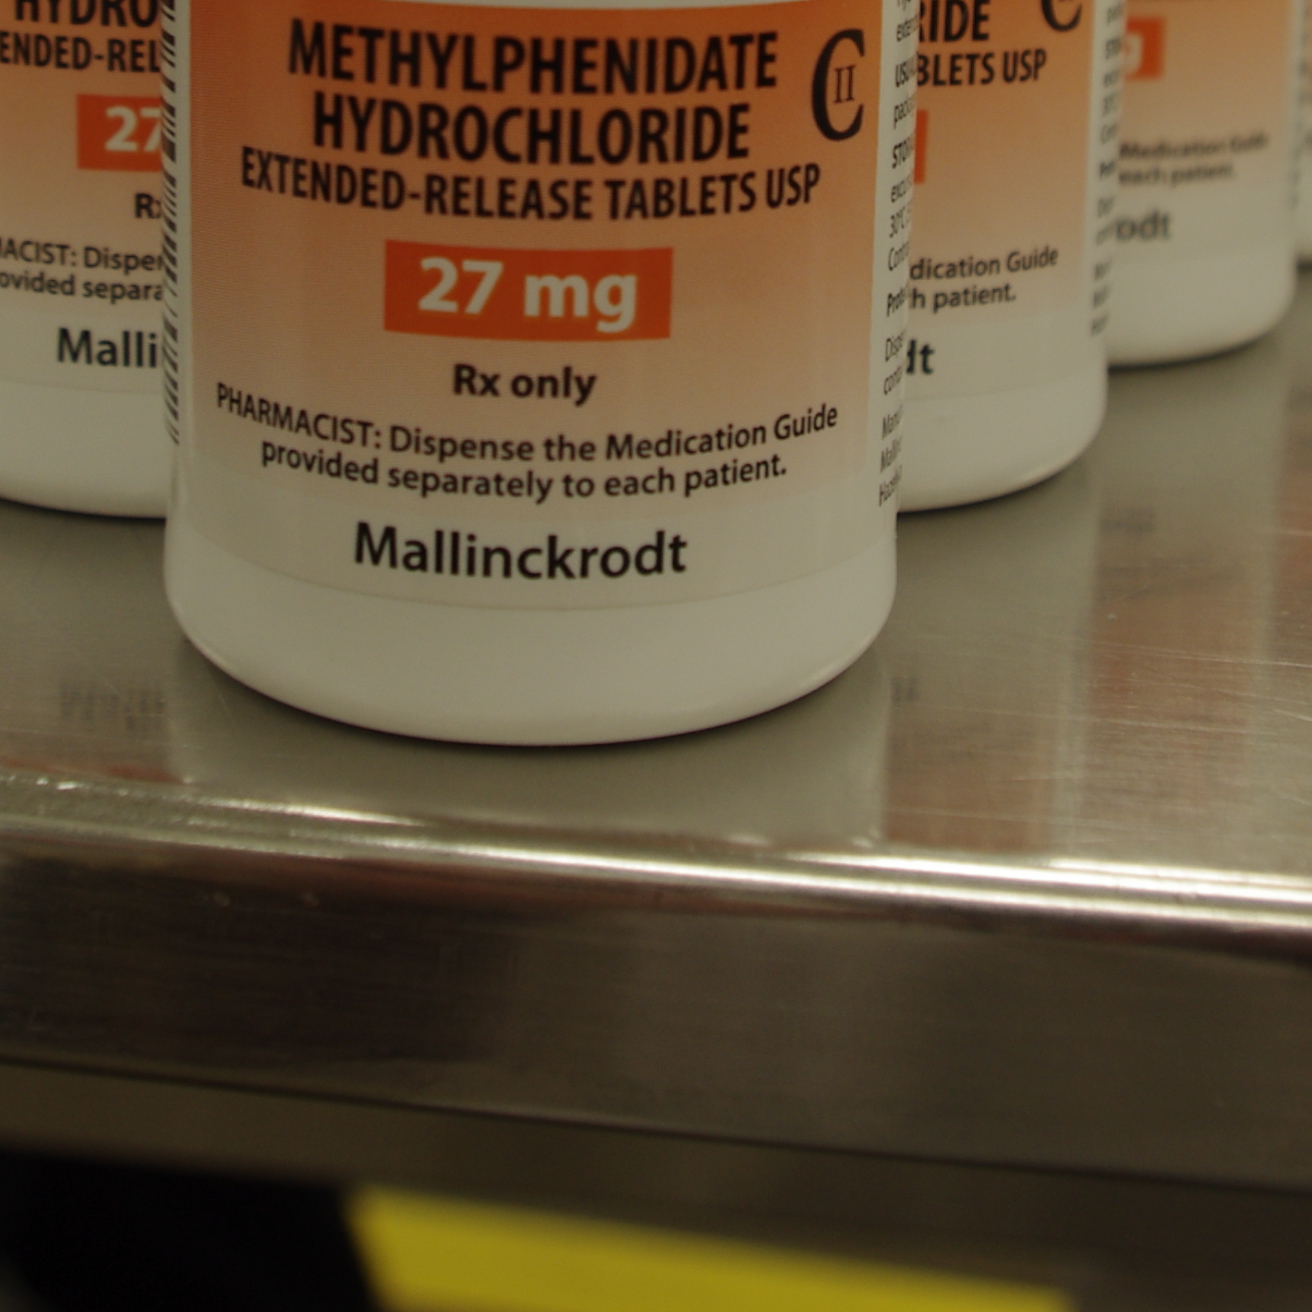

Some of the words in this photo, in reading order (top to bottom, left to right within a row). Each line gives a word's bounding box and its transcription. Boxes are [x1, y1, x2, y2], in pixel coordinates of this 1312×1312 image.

[287, 18, 779, 96] METHYLPHENIDATE
[1002, 48, 1048, 84] USP
[313, 91, 750, 165] HYDROCHLORIDE
[241, 145, 593, 221] EXTENDED-RELEASE
[608, 172, 757, 220] TABLETS
[764, 162, 821, 208] USP
[1006, 244, 1060, 275] Guide
[418, 257, 505, 316] 27
[523, 270, 639, 333] mg
[933, 283, 1017, 315] patient.
[452, 363, 500, 398] Rx
[511, 365, 598, 406] only
[216, 381, 383, 450] PHARMACIST:
[390, 424, 535, 470] Dispense
[544, 433, 597, 464] the
[606, 422, 767, 462] Medication
[773, 402, 839, 443] Guide
[261, 439, 379, 486] provided
[388, 463, 553, 504] separately
[562, 469, 596, 499] to
[603, 465, 677, 497] each
[684, 452, 788, 498] patient.
[352, 521, 688, 581] Mallinckrodt
